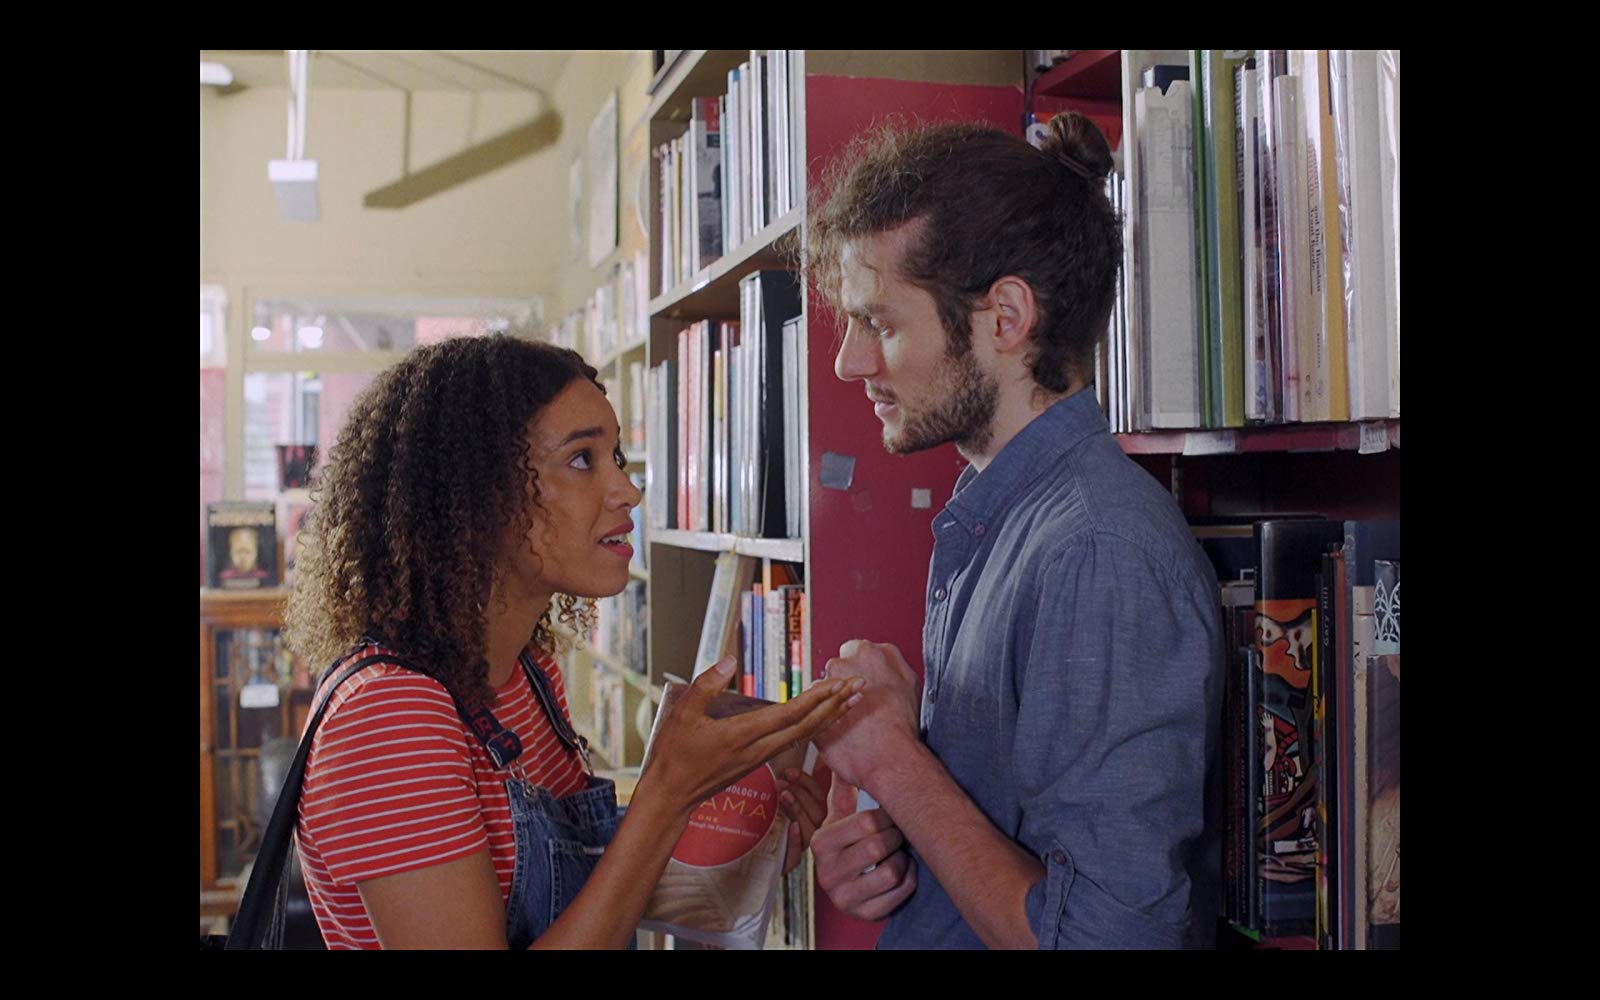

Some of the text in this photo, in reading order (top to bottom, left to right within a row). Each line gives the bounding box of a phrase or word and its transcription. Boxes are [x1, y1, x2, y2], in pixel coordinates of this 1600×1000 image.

[1321, 586, 1330, 647] Gary Hill
[697, 814, 720, 823] ONE
